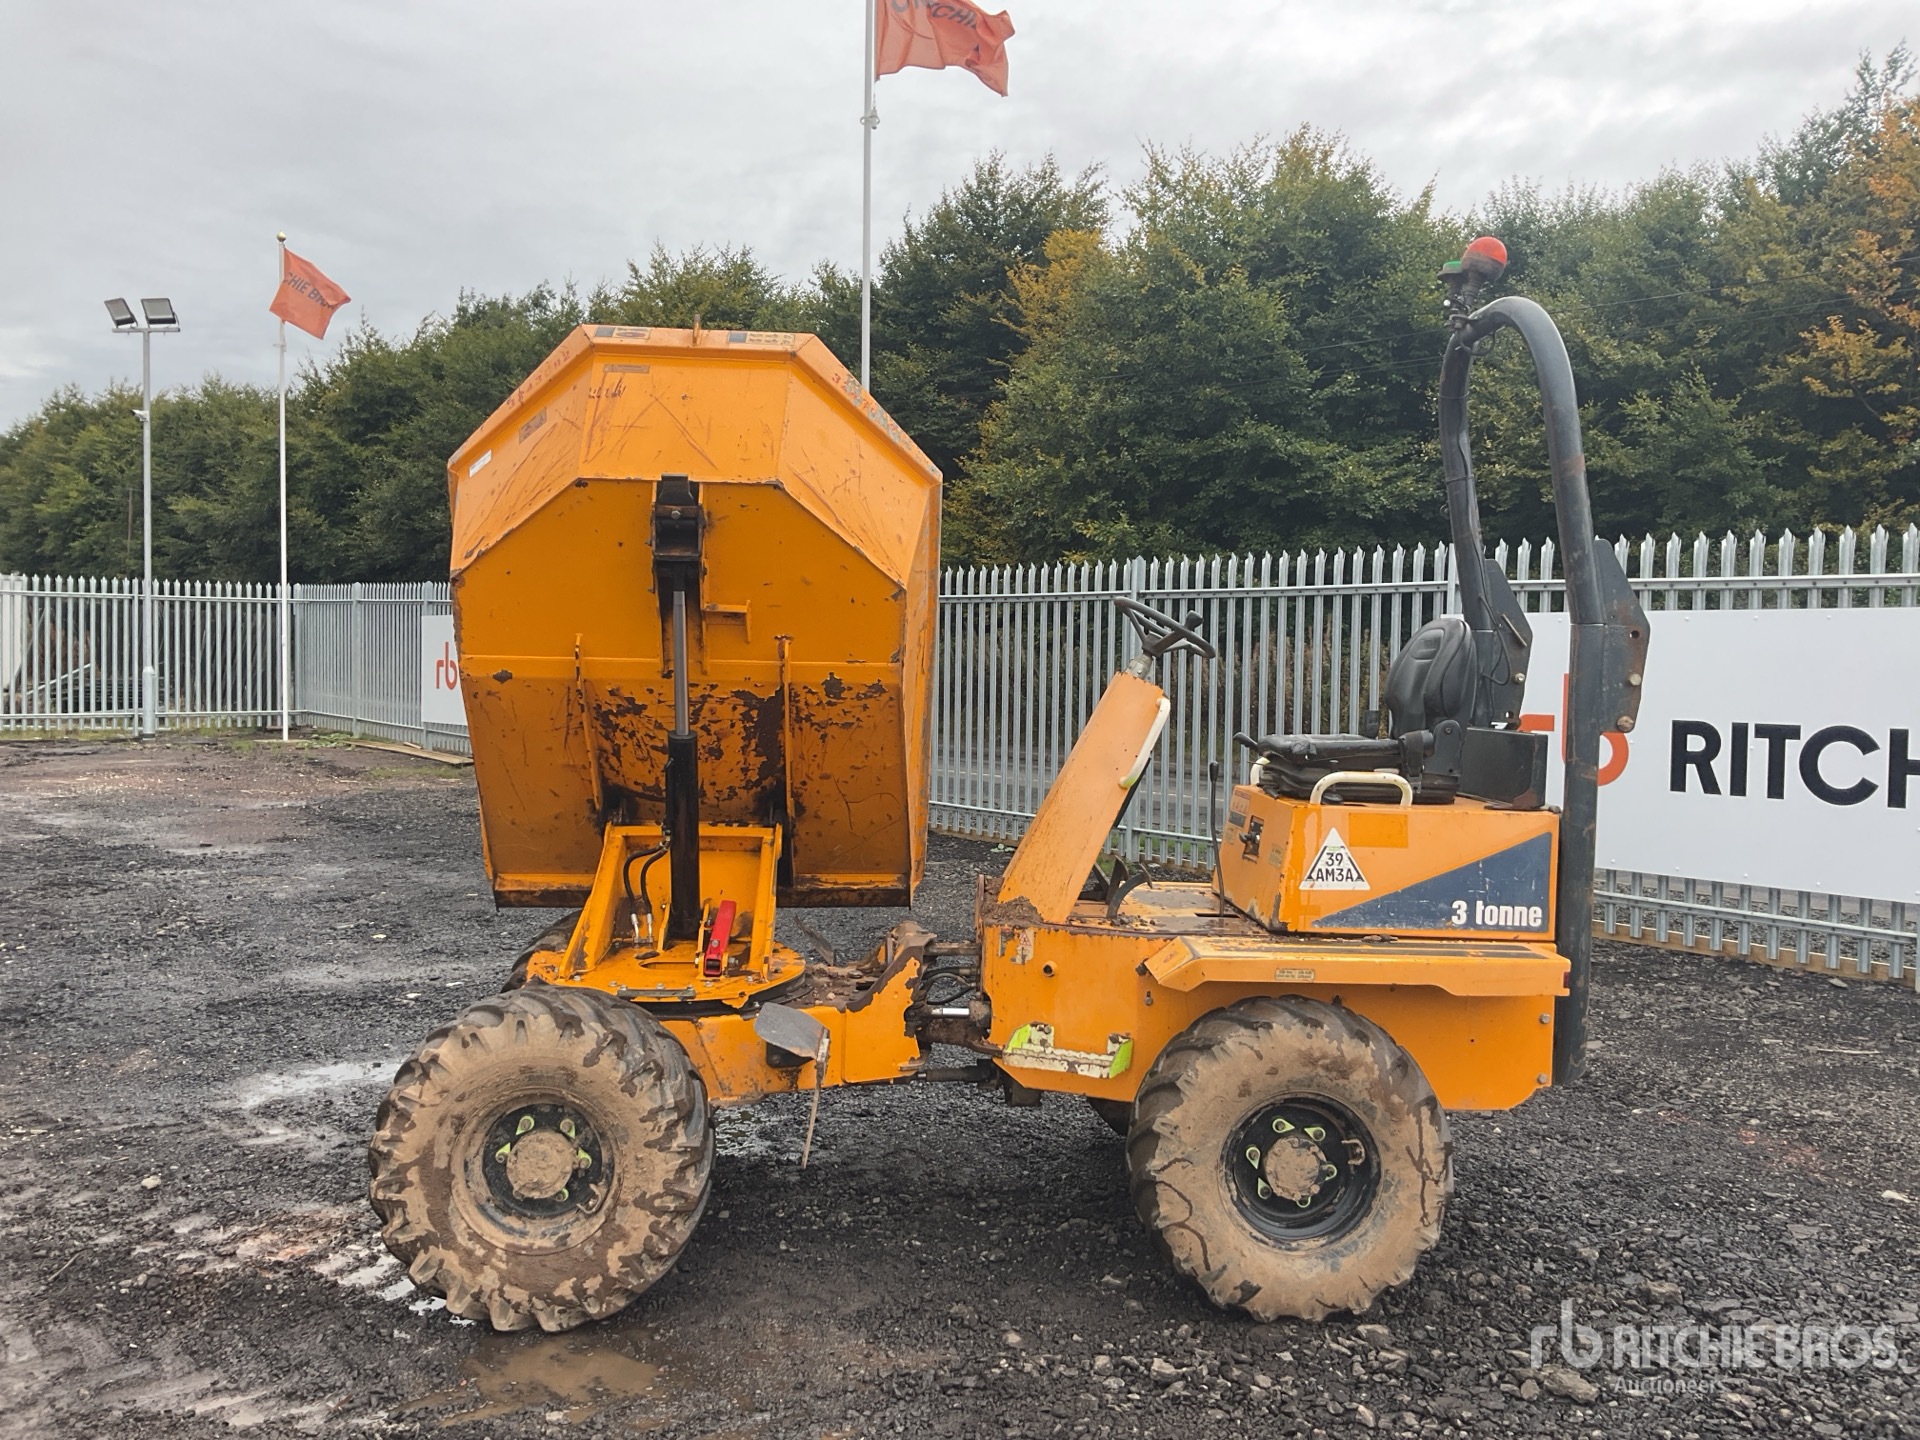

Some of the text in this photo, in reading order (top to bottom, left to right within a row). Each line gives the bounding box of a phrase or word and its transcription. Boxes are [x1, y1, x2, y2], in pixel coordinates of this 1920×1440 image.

[436, 641, 458, 690] rb
[1326, 852, 1344, 867] 39
[1316, 868, 1354, 882] AM3A
[1451, 900, 1543, 927] 3 tonne
